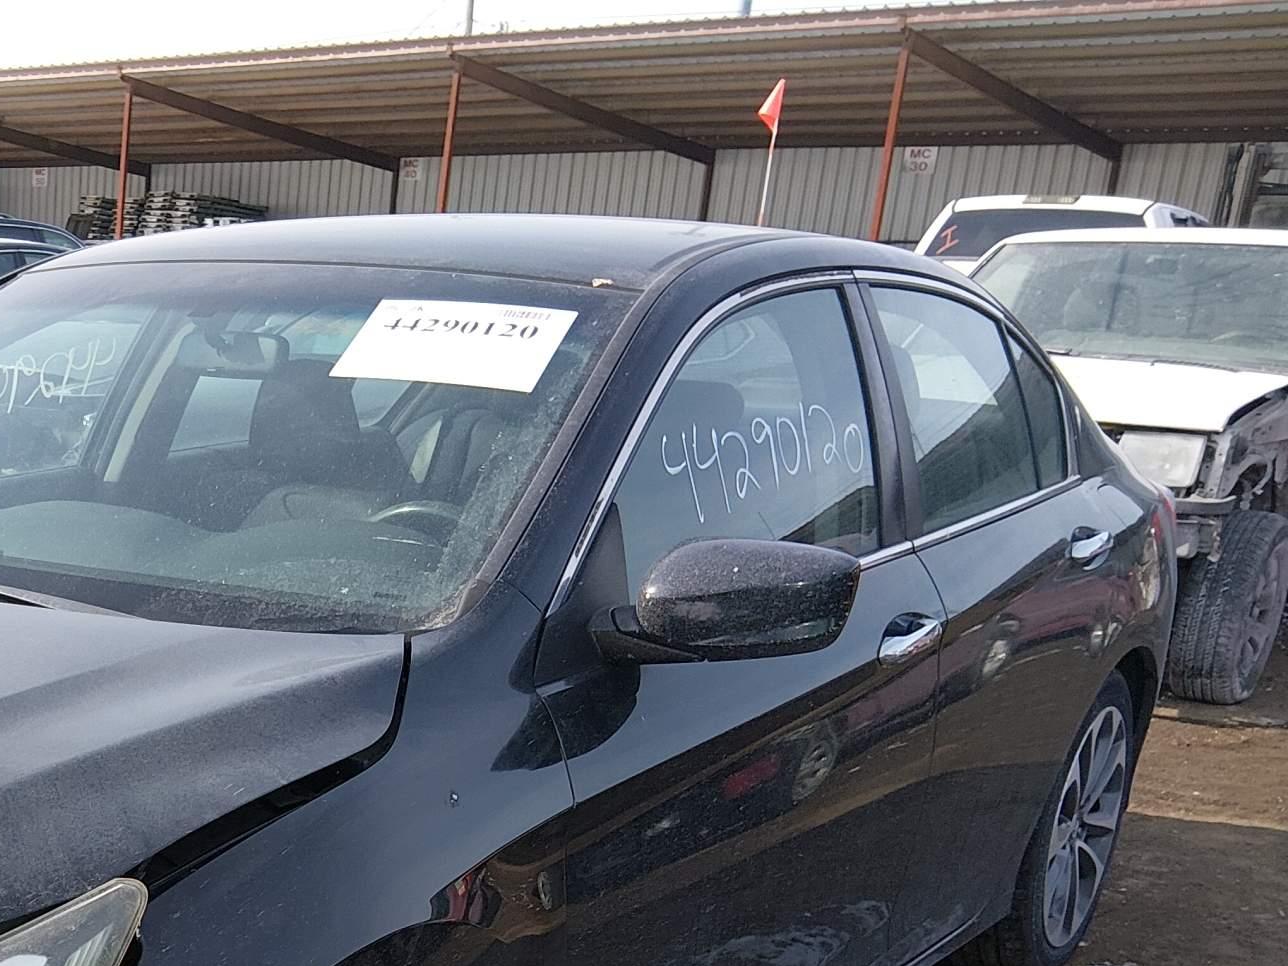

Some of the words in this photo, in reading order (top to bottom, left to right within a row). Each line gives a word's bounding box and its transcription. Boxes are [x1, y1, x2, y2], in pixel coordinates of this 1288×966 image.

[909, 148, 932, 159] MC
[910, 161, 928, 172] 30
[383, 317, 540, 340] 44290120
[662, 401, 864, 524] 44290120
